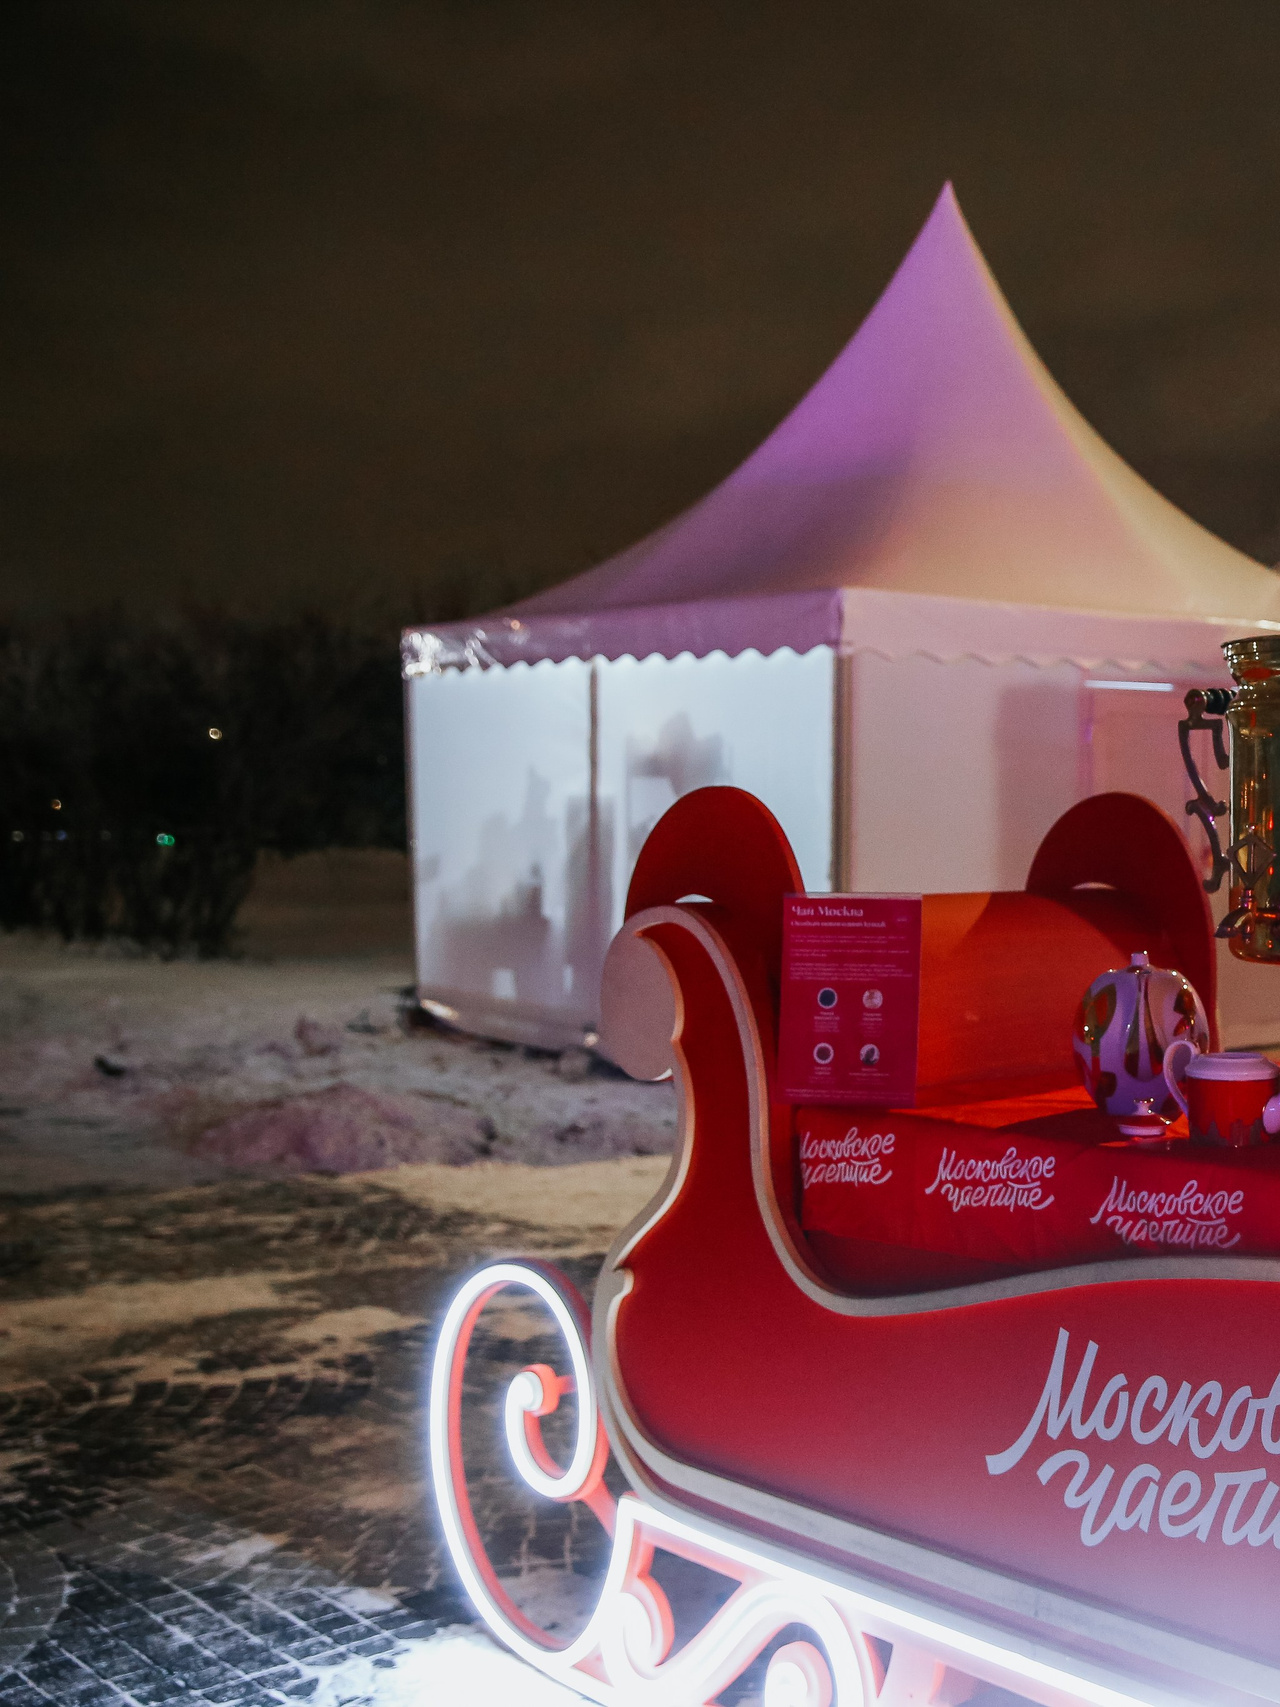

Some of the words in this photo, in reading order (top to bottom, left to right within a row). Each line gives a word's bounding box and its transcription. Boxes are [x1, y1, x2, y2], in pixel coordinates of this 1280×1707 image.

[925, 1147, 1056, 1195] Московское
[941, 1181, 1055, 1213] чаепитие
[1089, 1175, 1245, 1225] Московское
[1105, 1215, 1242, 1250] чаепитие
